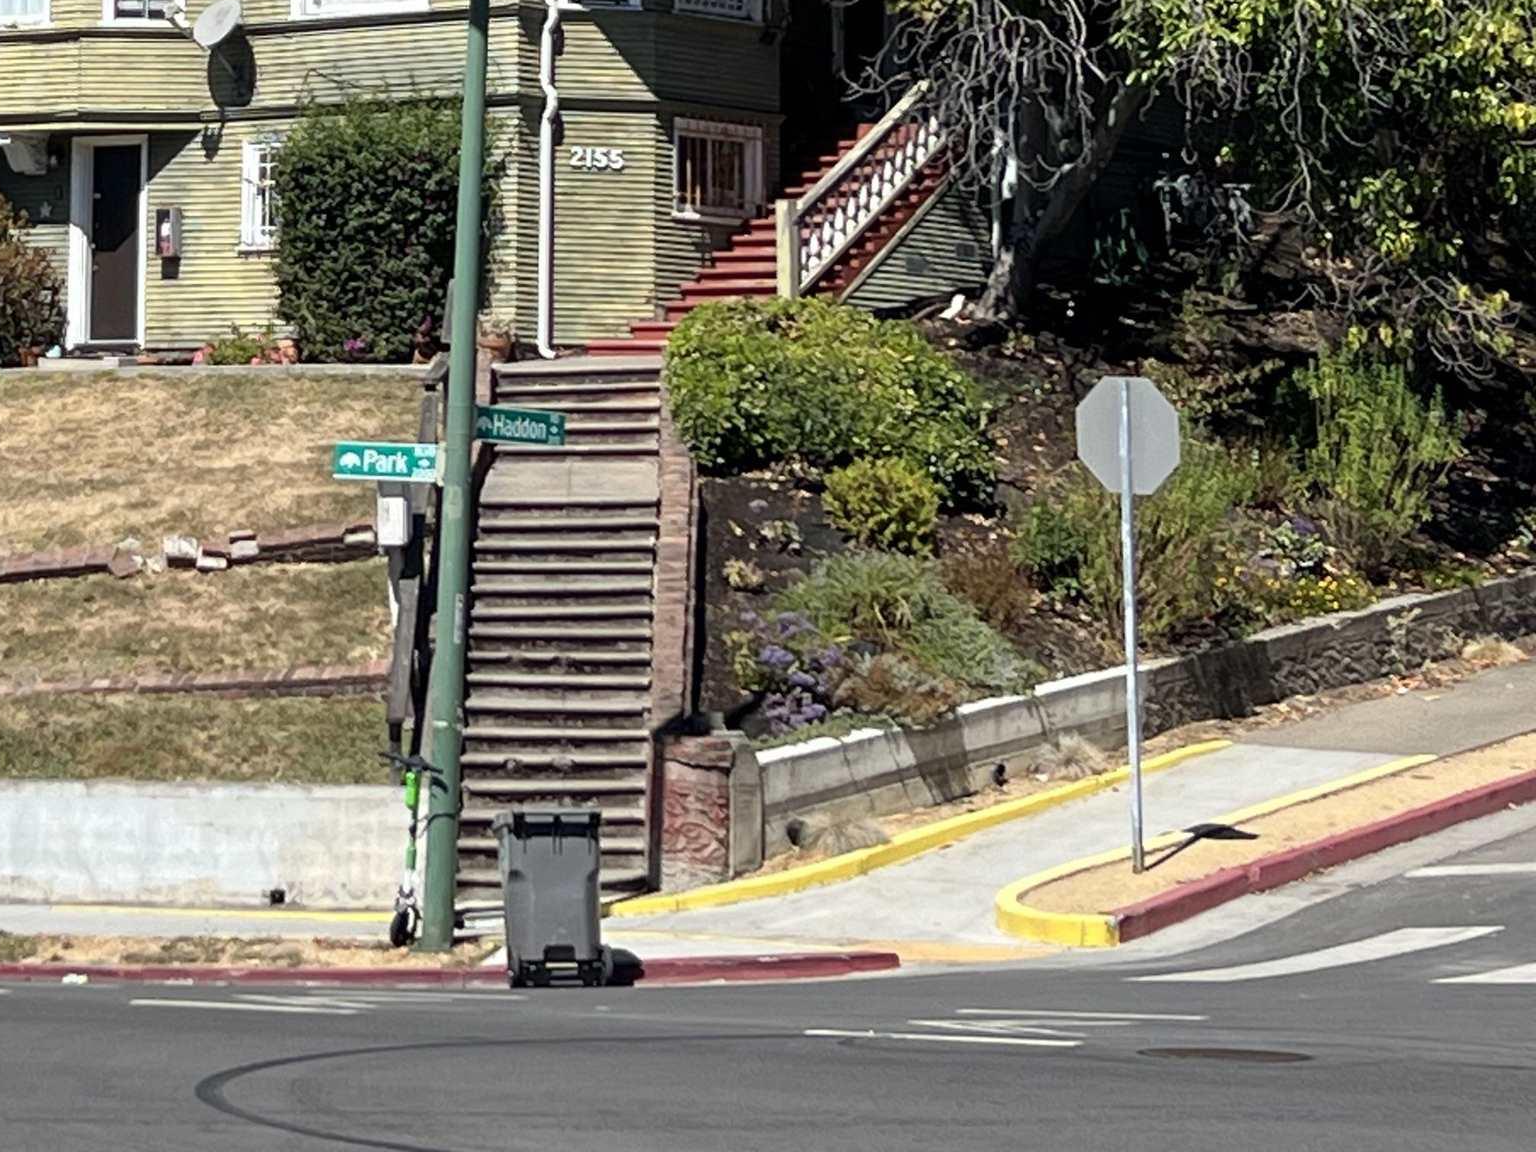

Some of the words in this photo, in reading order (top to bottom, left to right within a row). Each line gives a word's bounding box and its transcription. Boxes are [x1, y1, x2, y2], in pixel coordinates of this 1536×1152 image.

[569, 145, 625, 169] 2155
[492, 414, 547, 440] Haddon
[363, 448, 408, 473] Park
